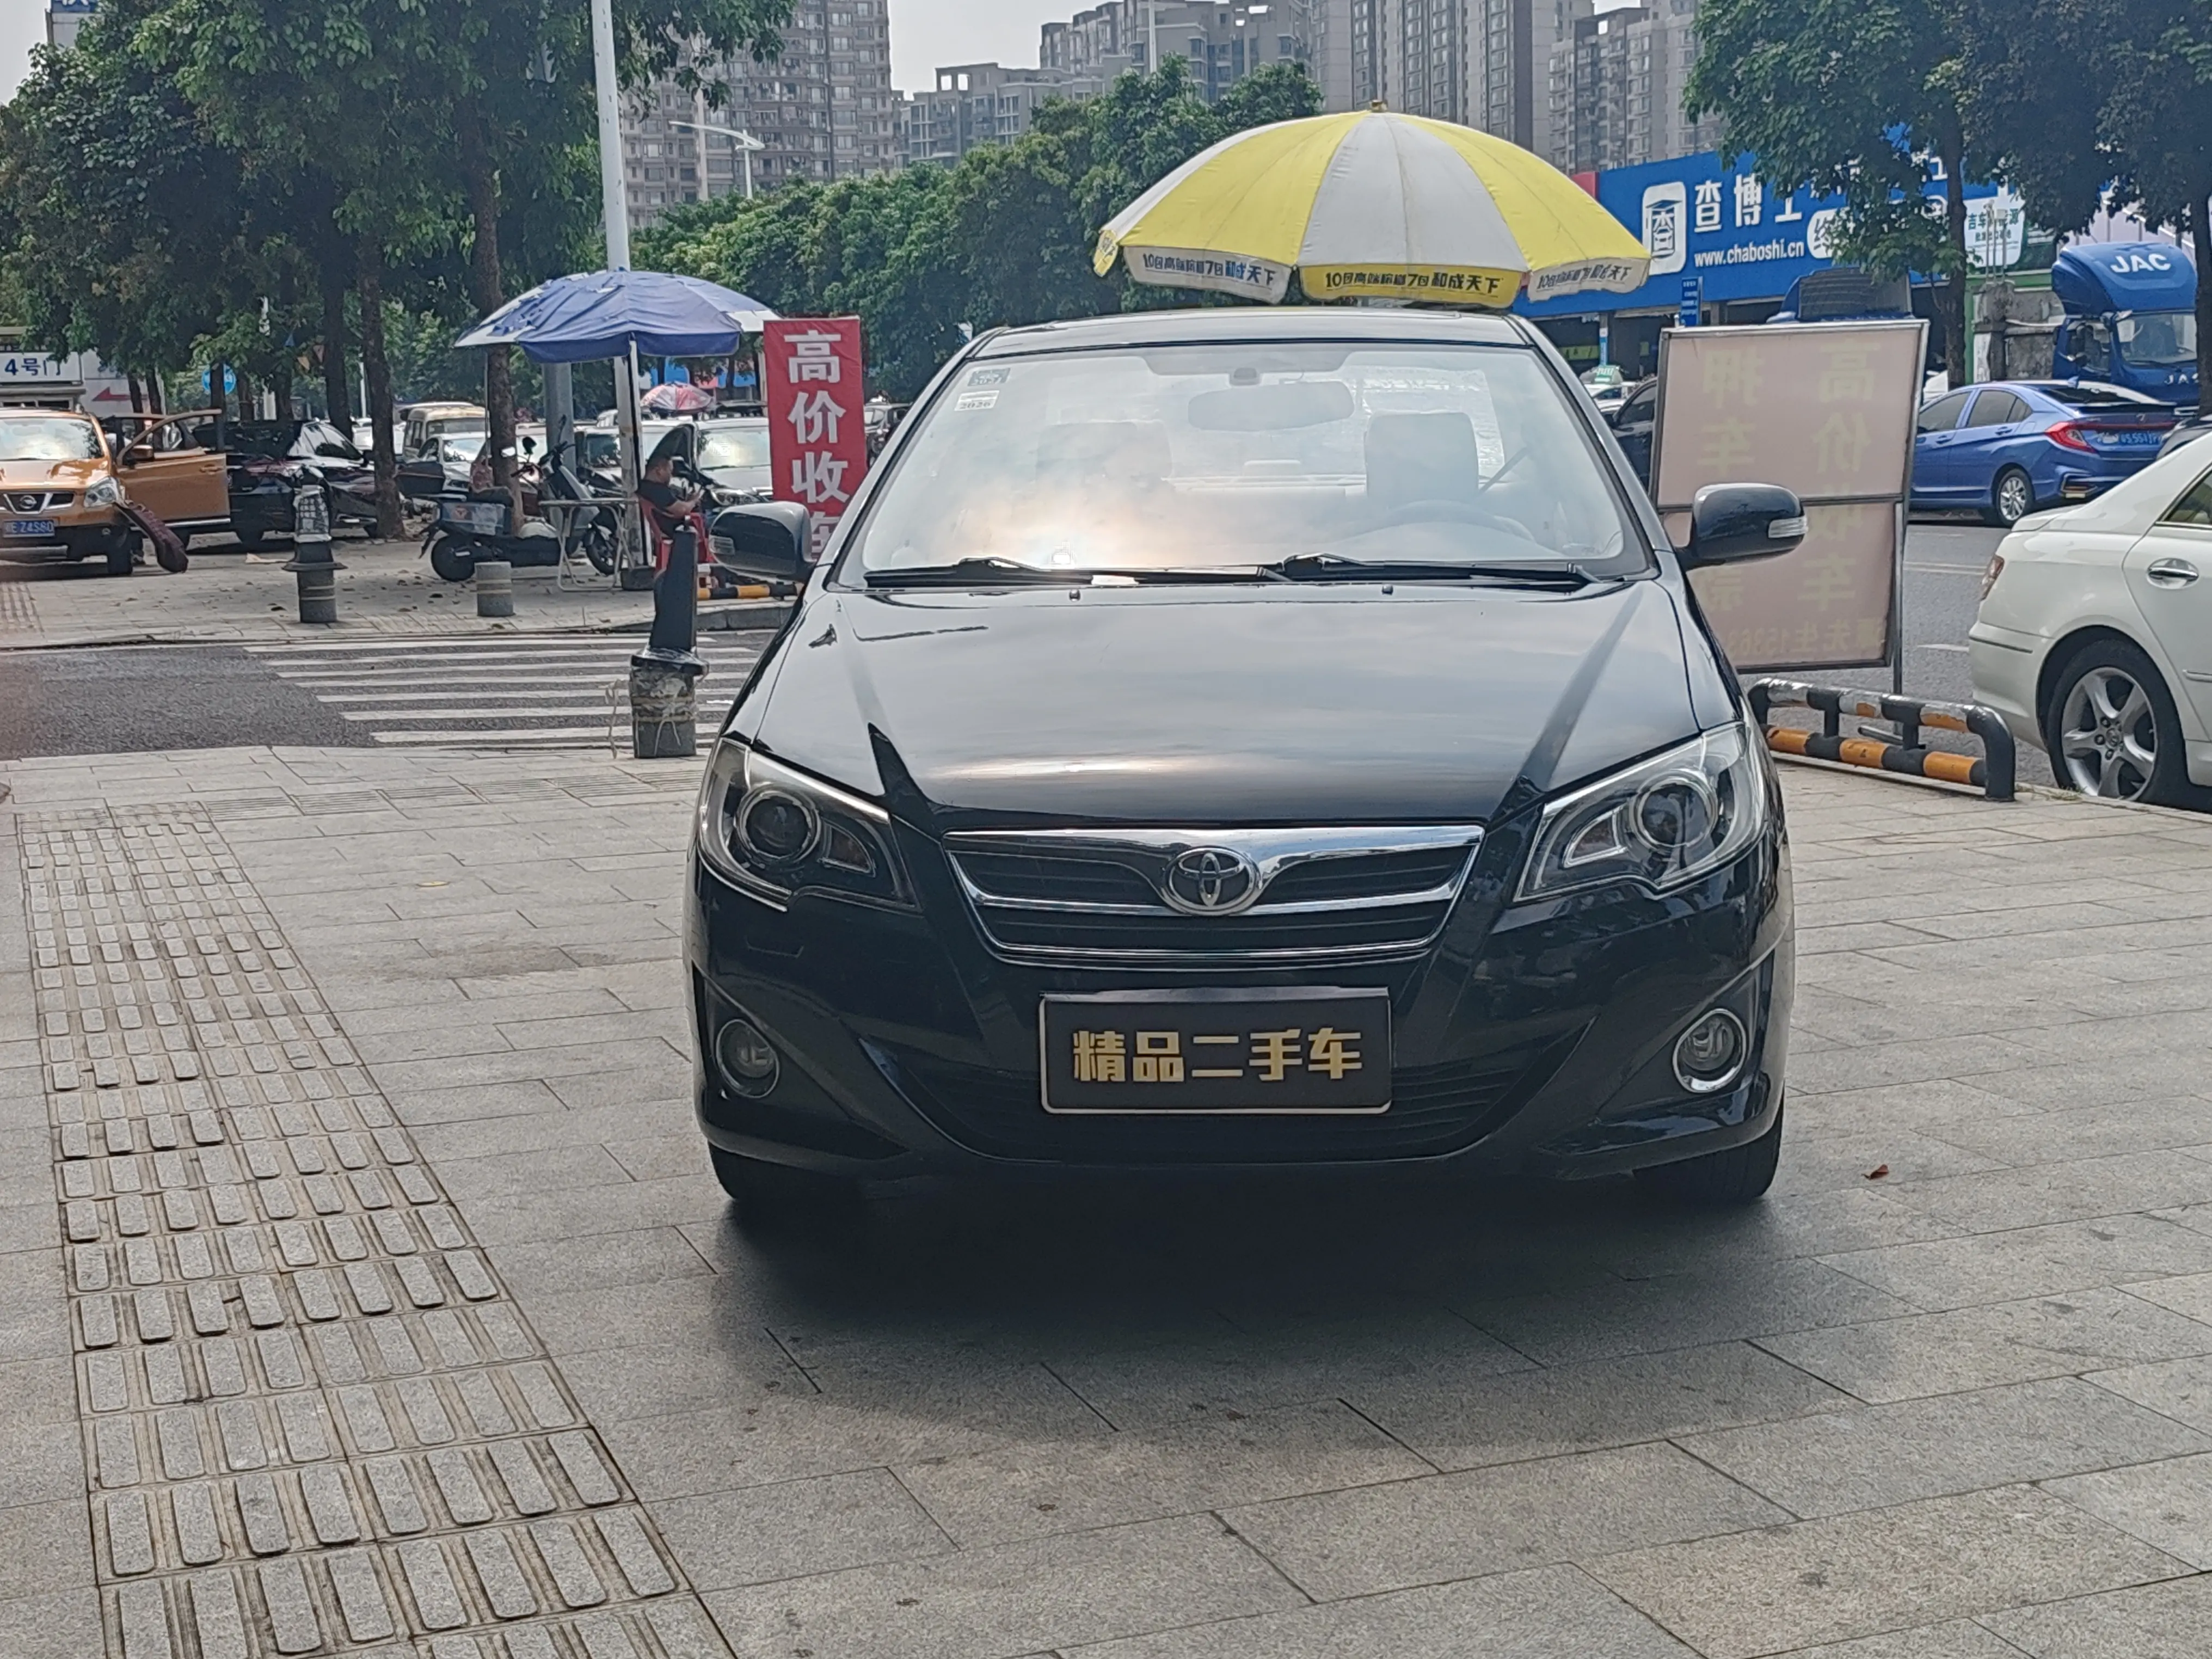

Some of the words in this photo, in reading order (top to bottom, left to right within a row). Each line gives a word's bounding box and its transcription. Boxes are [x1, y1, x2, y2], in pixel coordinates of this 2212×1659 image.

[1694, 238, 1804, 267] www.chaboshi.cn
[2111, 253, 2171, 273] JAC
[1073, 1027, 1362, 1082] 精品二手车
